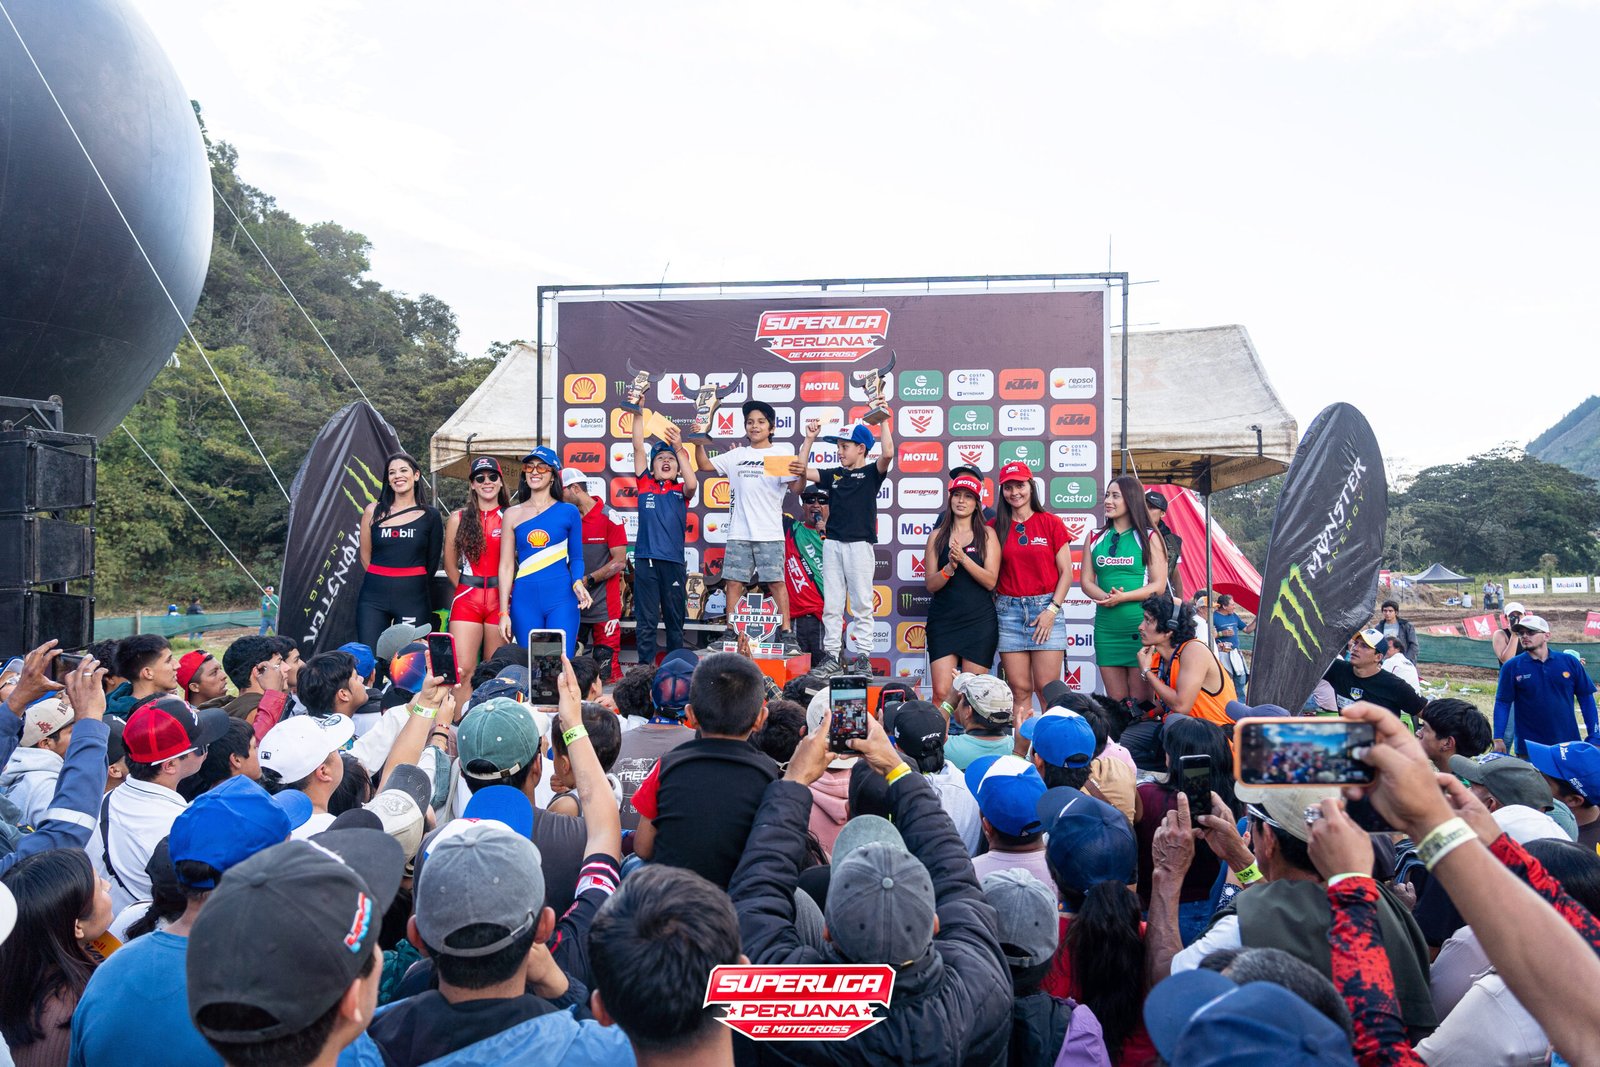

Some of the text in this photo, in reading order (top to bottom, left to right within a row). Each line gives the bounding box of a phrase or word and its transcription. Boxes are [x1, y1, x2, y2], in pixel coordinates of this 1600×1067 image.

[764, 315, 882, 330] SUPERLIGA
[781, 336, 864, 347] PERUANA
[1005, 378, 1039, 390] KTM
[1068, 377, 1094, 385] repsol
[804, 383, 839, 391] MOTUL
[903, 387, 939, 396] Castrol
[581, 417, 604, 425] repsol
[1056, 414, 1091, 425] KTM
[952, 422, 989, 431] Castrol
[569, 452, 600, 463] KTM
[903, 453, 939, 461] MOTUL
[957, 480, 978, 490] MOTUL
[1055, 494, 1092, 503] Castrol
[1306, 457, 1367, 579] MONSTER
[381, 528, 414, 538] Mobil
[1326, 493, 1365, 574] ENERGY
[1105, 557, 1133, 565] Castrol
[304, 530, 345, 616] ENERGY
[1067, 634, 1092, 646] obil
[921, 732, 941, 742] FOX
